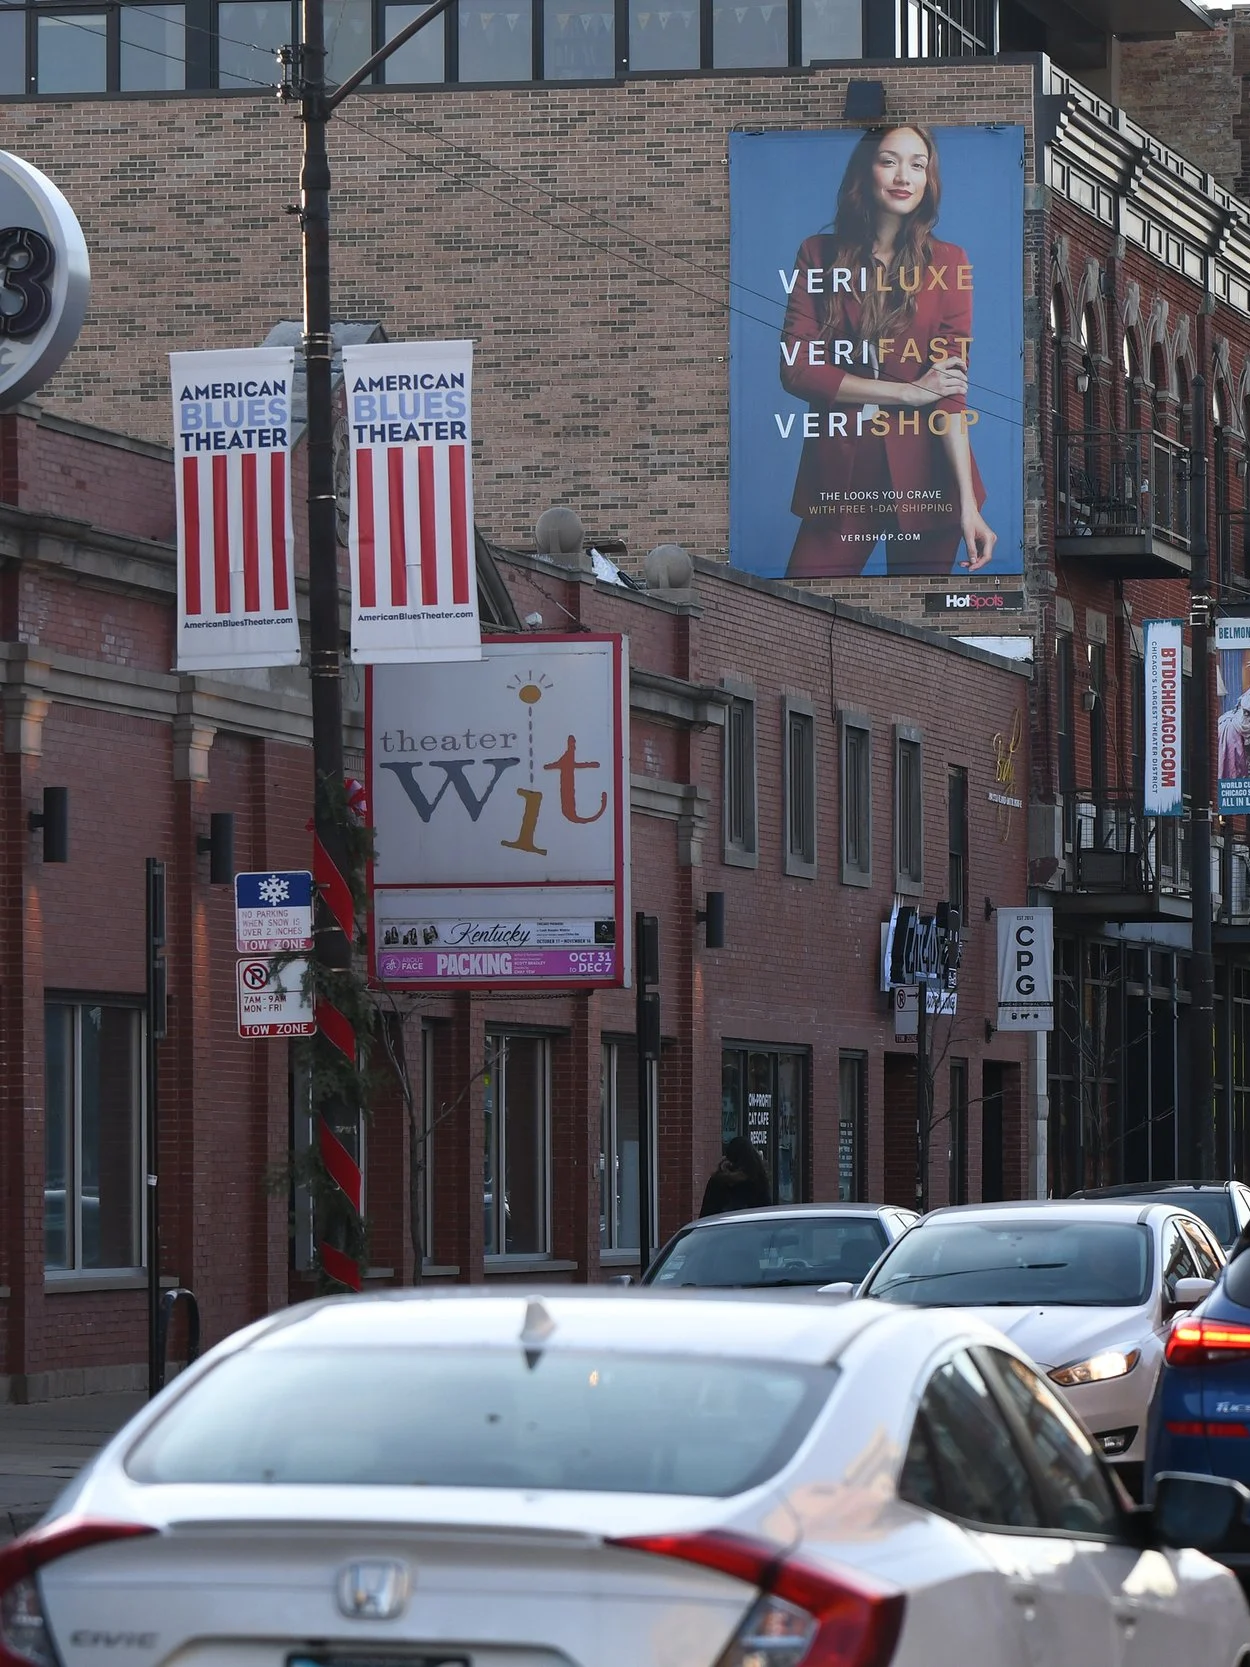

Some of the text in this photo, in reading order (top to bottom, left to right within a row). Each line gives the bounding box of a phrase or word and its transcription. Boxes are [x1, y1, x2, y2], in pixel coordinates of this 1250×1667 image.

[778, 264, 974, 295] VERILUXE
[780, 337, 974, 367] VERIFAST
[352, 373, 465, 393] AMERICAN
[180, 380, 286, 401] AMERICAN
[353, 391, 466, 422] BLUES
[181, 398, 288, 430] BLUES
[774, 409, 980, 440] VERISHOP
[353, 421, 467, 443] THEATER
[180, 428, 288, 451] THEATER
[820, 490, 941, 501] THE LOOKS YOU CRAVE
[809, 503, 953, 514] WITH FREE 1-DAY SHIPPING
[840, 533, 921, 542] VERISHOP.COM
[946, 594, 1004, 609] HotSpots
[184, 616, 293, 629] AmericanBluesTheater.com
[358, 611, 474, 622] AmericanBluesTheater.com
[1161, 648, 1176, 788] BTDCHICAGO.COM
[380, 728, 518, 752] theater
[1221, 781, 1242, 789] WORLD
[379, 734, 607, 856] wit
[1221, 789, 1247, 797] CHICAGO
[1222, 797, 1235, 807] ALL
[1236, 797, 1244, 806] IN
[242, 910, 288, 919] NO PARKING
[242, 917, 300, 927] WHEN SNOW IS
[243, 927, 303, 936] OVER 2 INCHES
[444, 922, 531, 946] Kentucky
[242, 939, 307, 950] TOW ZONE
[569, 952, 611, 962] OCT 31
[1015, 926, 1035, 995] CPG
[437, 953, 513, 976] PACKING
[579, 963, 602, 972] DEC
[605, 963, 612, 972] 7
[244, 995, 261, 1003] 7AM
[244, 1003, 282, 1012] MON FRI
[244, 1024, 308, 1035] TOW ZONE
[70, 1630, 159, 1649] CIVIC
